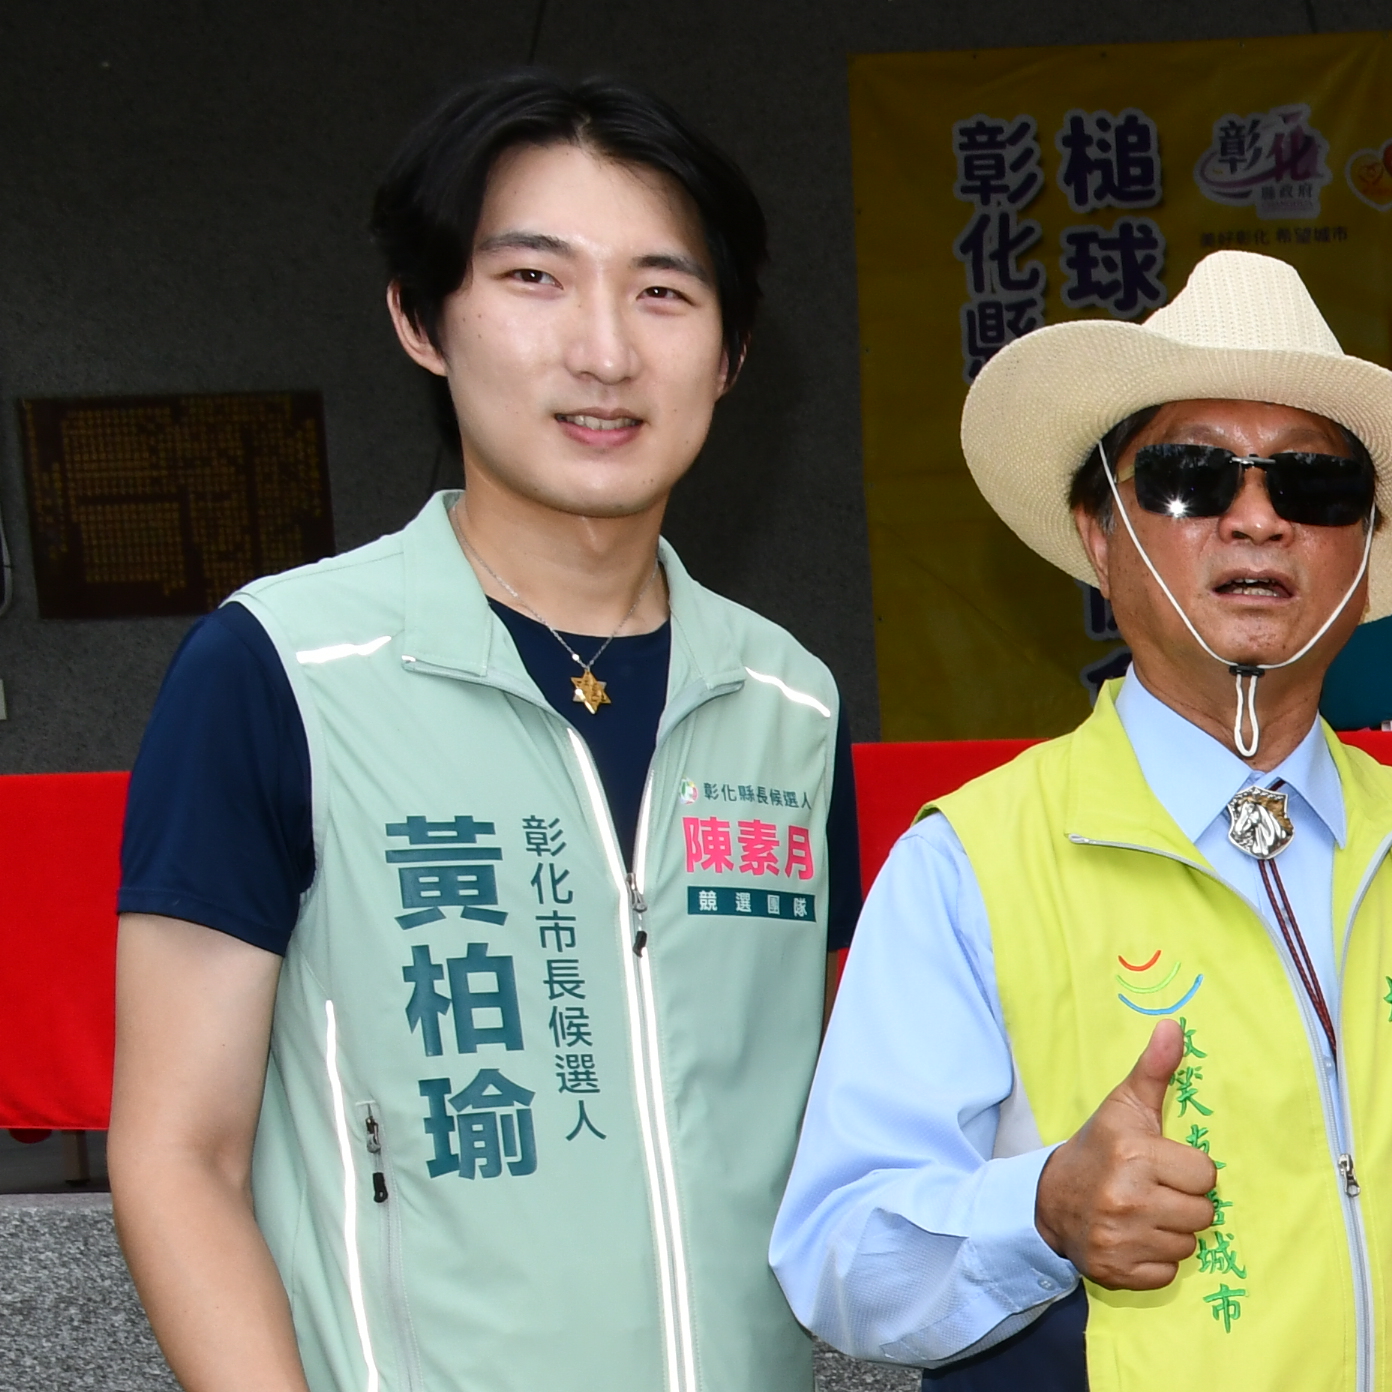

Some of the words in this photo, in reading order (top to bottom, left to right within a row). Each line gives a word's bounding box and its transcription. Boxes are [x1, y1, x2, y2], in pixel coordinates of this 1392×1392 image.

[1064, 115, 1162, 311] 槌球
[682, 816, 815, 881] 陳素月
[703, 782, 813, 811] 彰化縣長候選人
[698, 889, 808, 918] 競選團隊
[384, 814, 539, 1181] 黃柏瑜
[521, 814, 607, 1143] 彰化市長候選人
